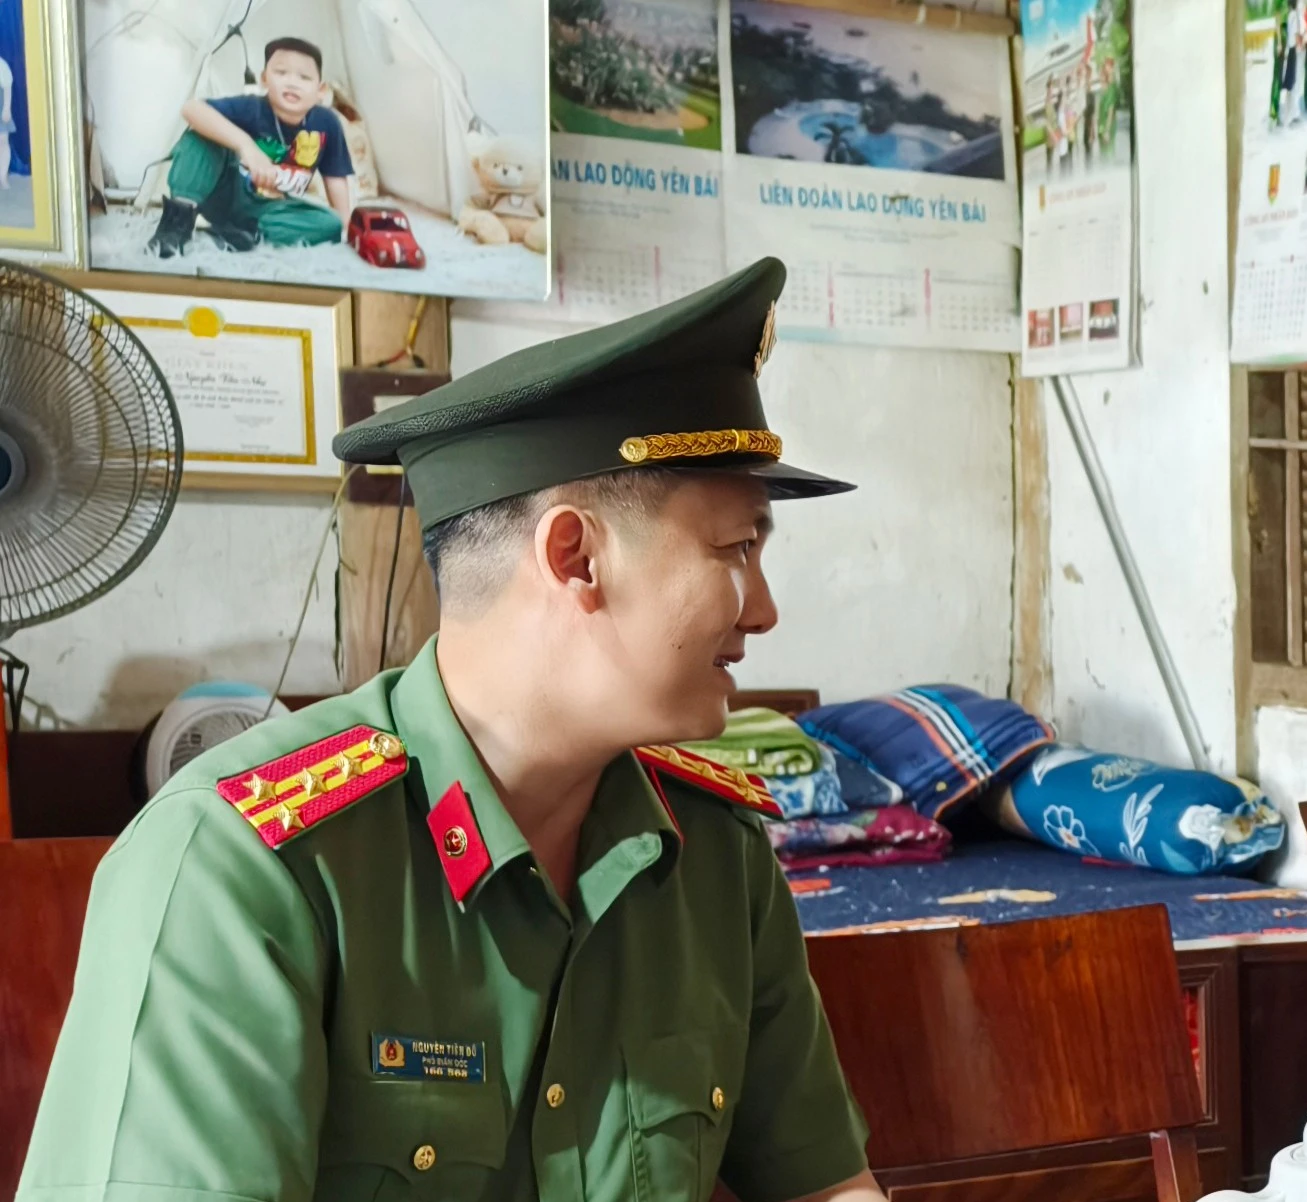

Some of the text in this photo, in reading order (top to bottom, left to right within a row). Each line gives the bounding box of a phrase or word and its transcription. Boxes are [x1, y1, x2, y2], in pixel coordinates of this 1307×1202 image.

[574, 160, 607, 185] LAO
[661, 165, 690, 195] YÊN
[760, 180, 793, 206] LIÊN
[798, 182, 842, 209] ĐOÀN
[847, 190, 878, 213] LAO
[930, 193, 957, 220] YÊN
[962, 199, 987, 223] BÁI
